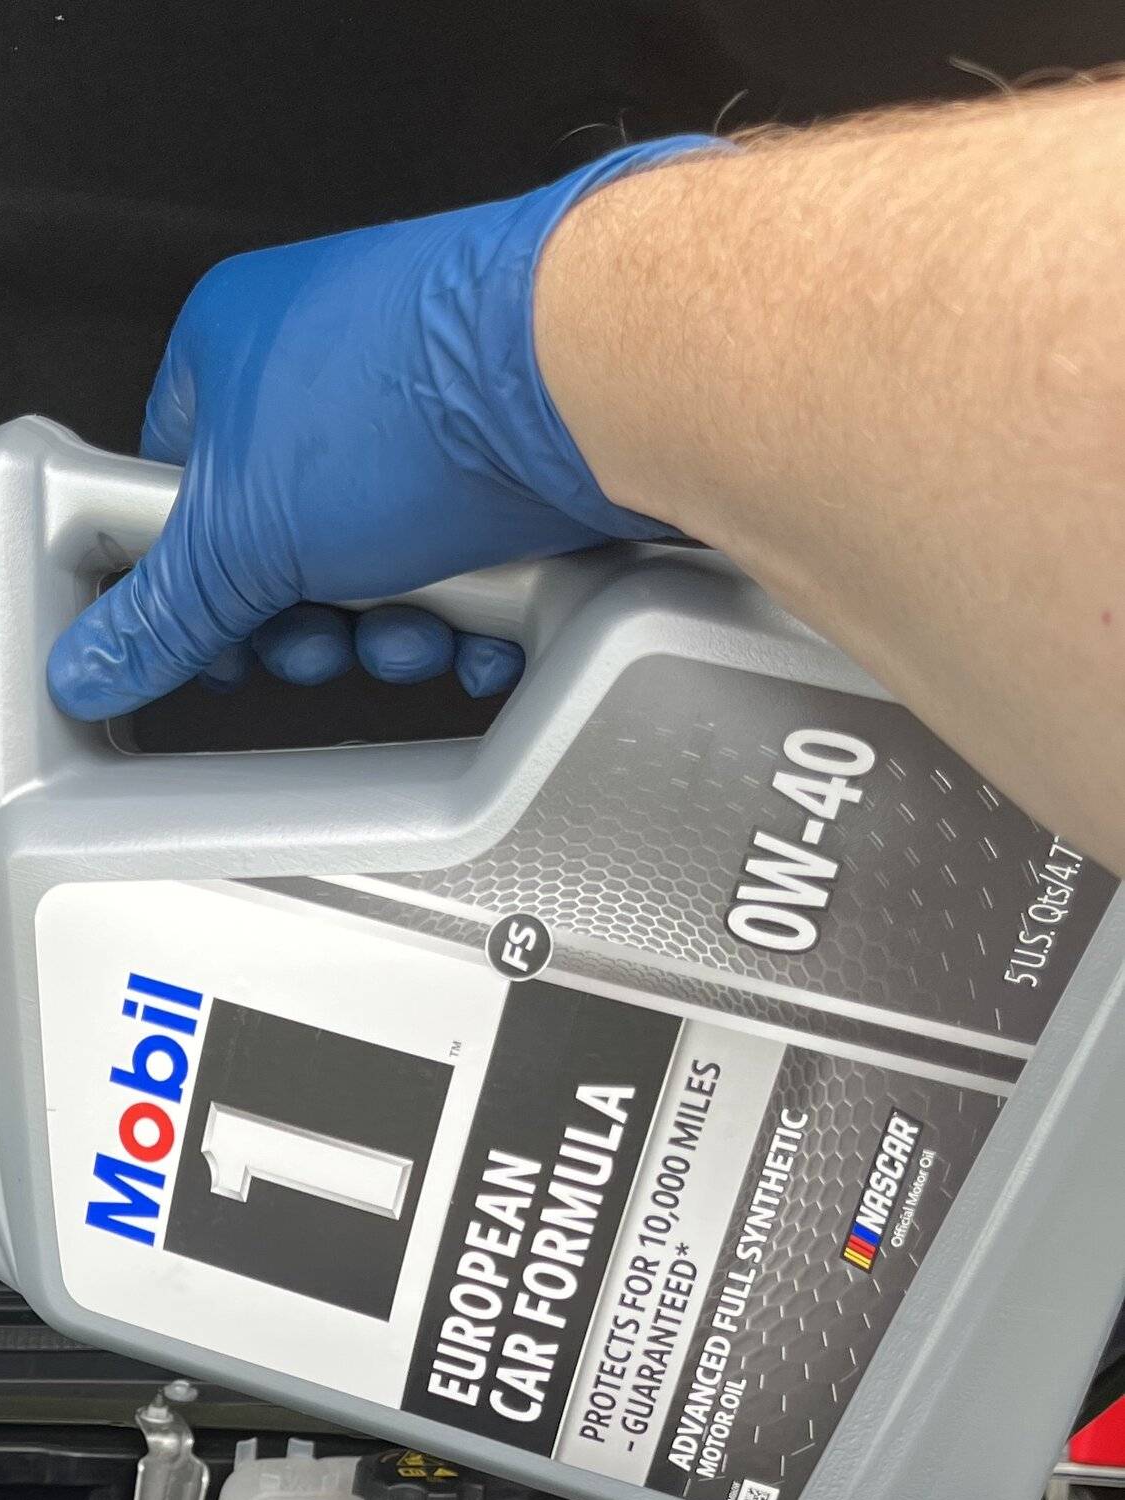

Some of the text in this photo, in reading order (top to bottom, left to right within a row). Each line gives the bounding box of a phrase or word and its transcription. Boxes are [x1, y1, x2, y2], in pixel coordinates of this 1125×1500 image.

[727, 728, 875, 951] 0W-40
[1027, 835, 1084, 923] Qts/4.7
[500, 921, 537, 972] FS
[85, 971, 204, 1247] Mobil
[200, 1100, 415, 1221] 1
[855, 1115, 919, 1236] NASCAR
[427, 1148, 542, 1407] EUROPEAN
[488, 1083, 636, 1424] CAR FORMULA
[579, 1059, 722, 1444] PROTECTS FOR 10,000 MILES
[890, 1149, 937, 1248] Official Motor Oil
[668, 1335, 732, 1472] ADVANCED
[711, 1268, 756, 1333] FULL
[736, 1107, 809, 1264] SYNTHETIC
[695, 1410, 735, 1479] MOTOR
[719, 1378, 748, 1411] OIL
